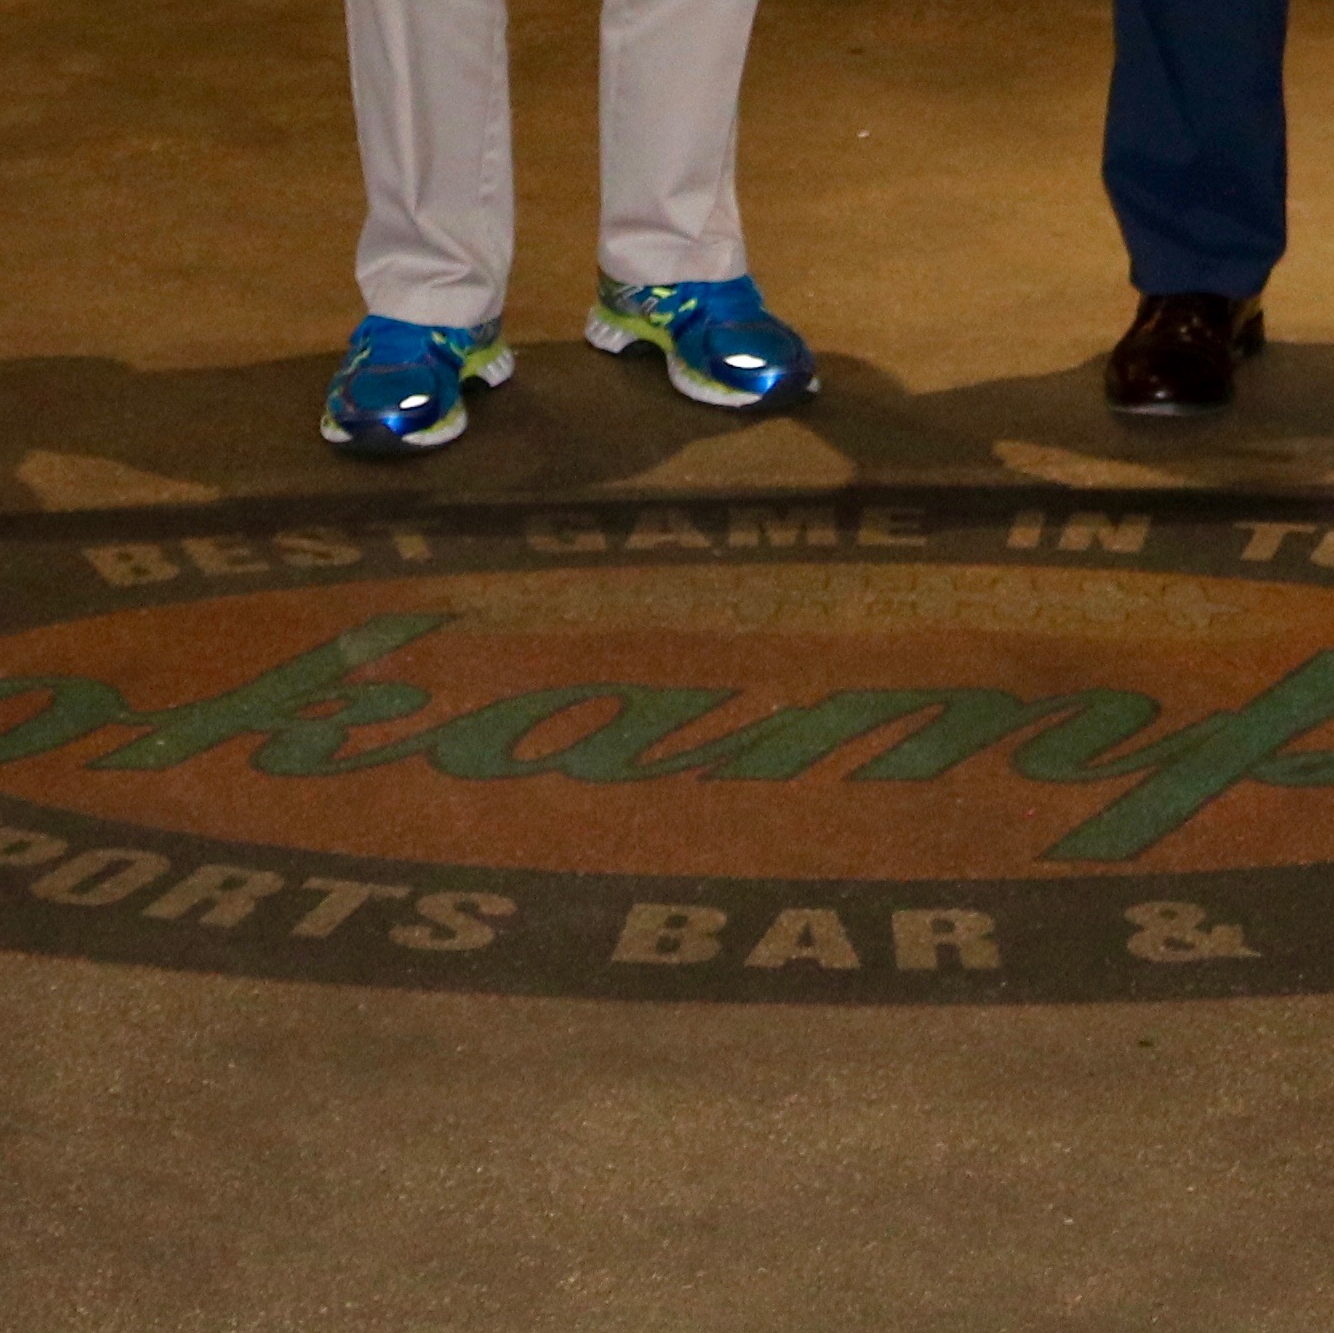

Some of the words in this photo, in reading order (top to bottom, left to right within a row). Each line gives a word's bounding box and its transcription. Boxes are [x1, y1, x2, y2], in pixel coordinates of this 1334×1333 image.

[82, 521, 440, 589] BEST
[520, 505, 931, 554] GAME
[1005, 507, 1154, 555] IN
[608, 900, 1003, 971] BAR
[1120, 897, 1264, 965] &
